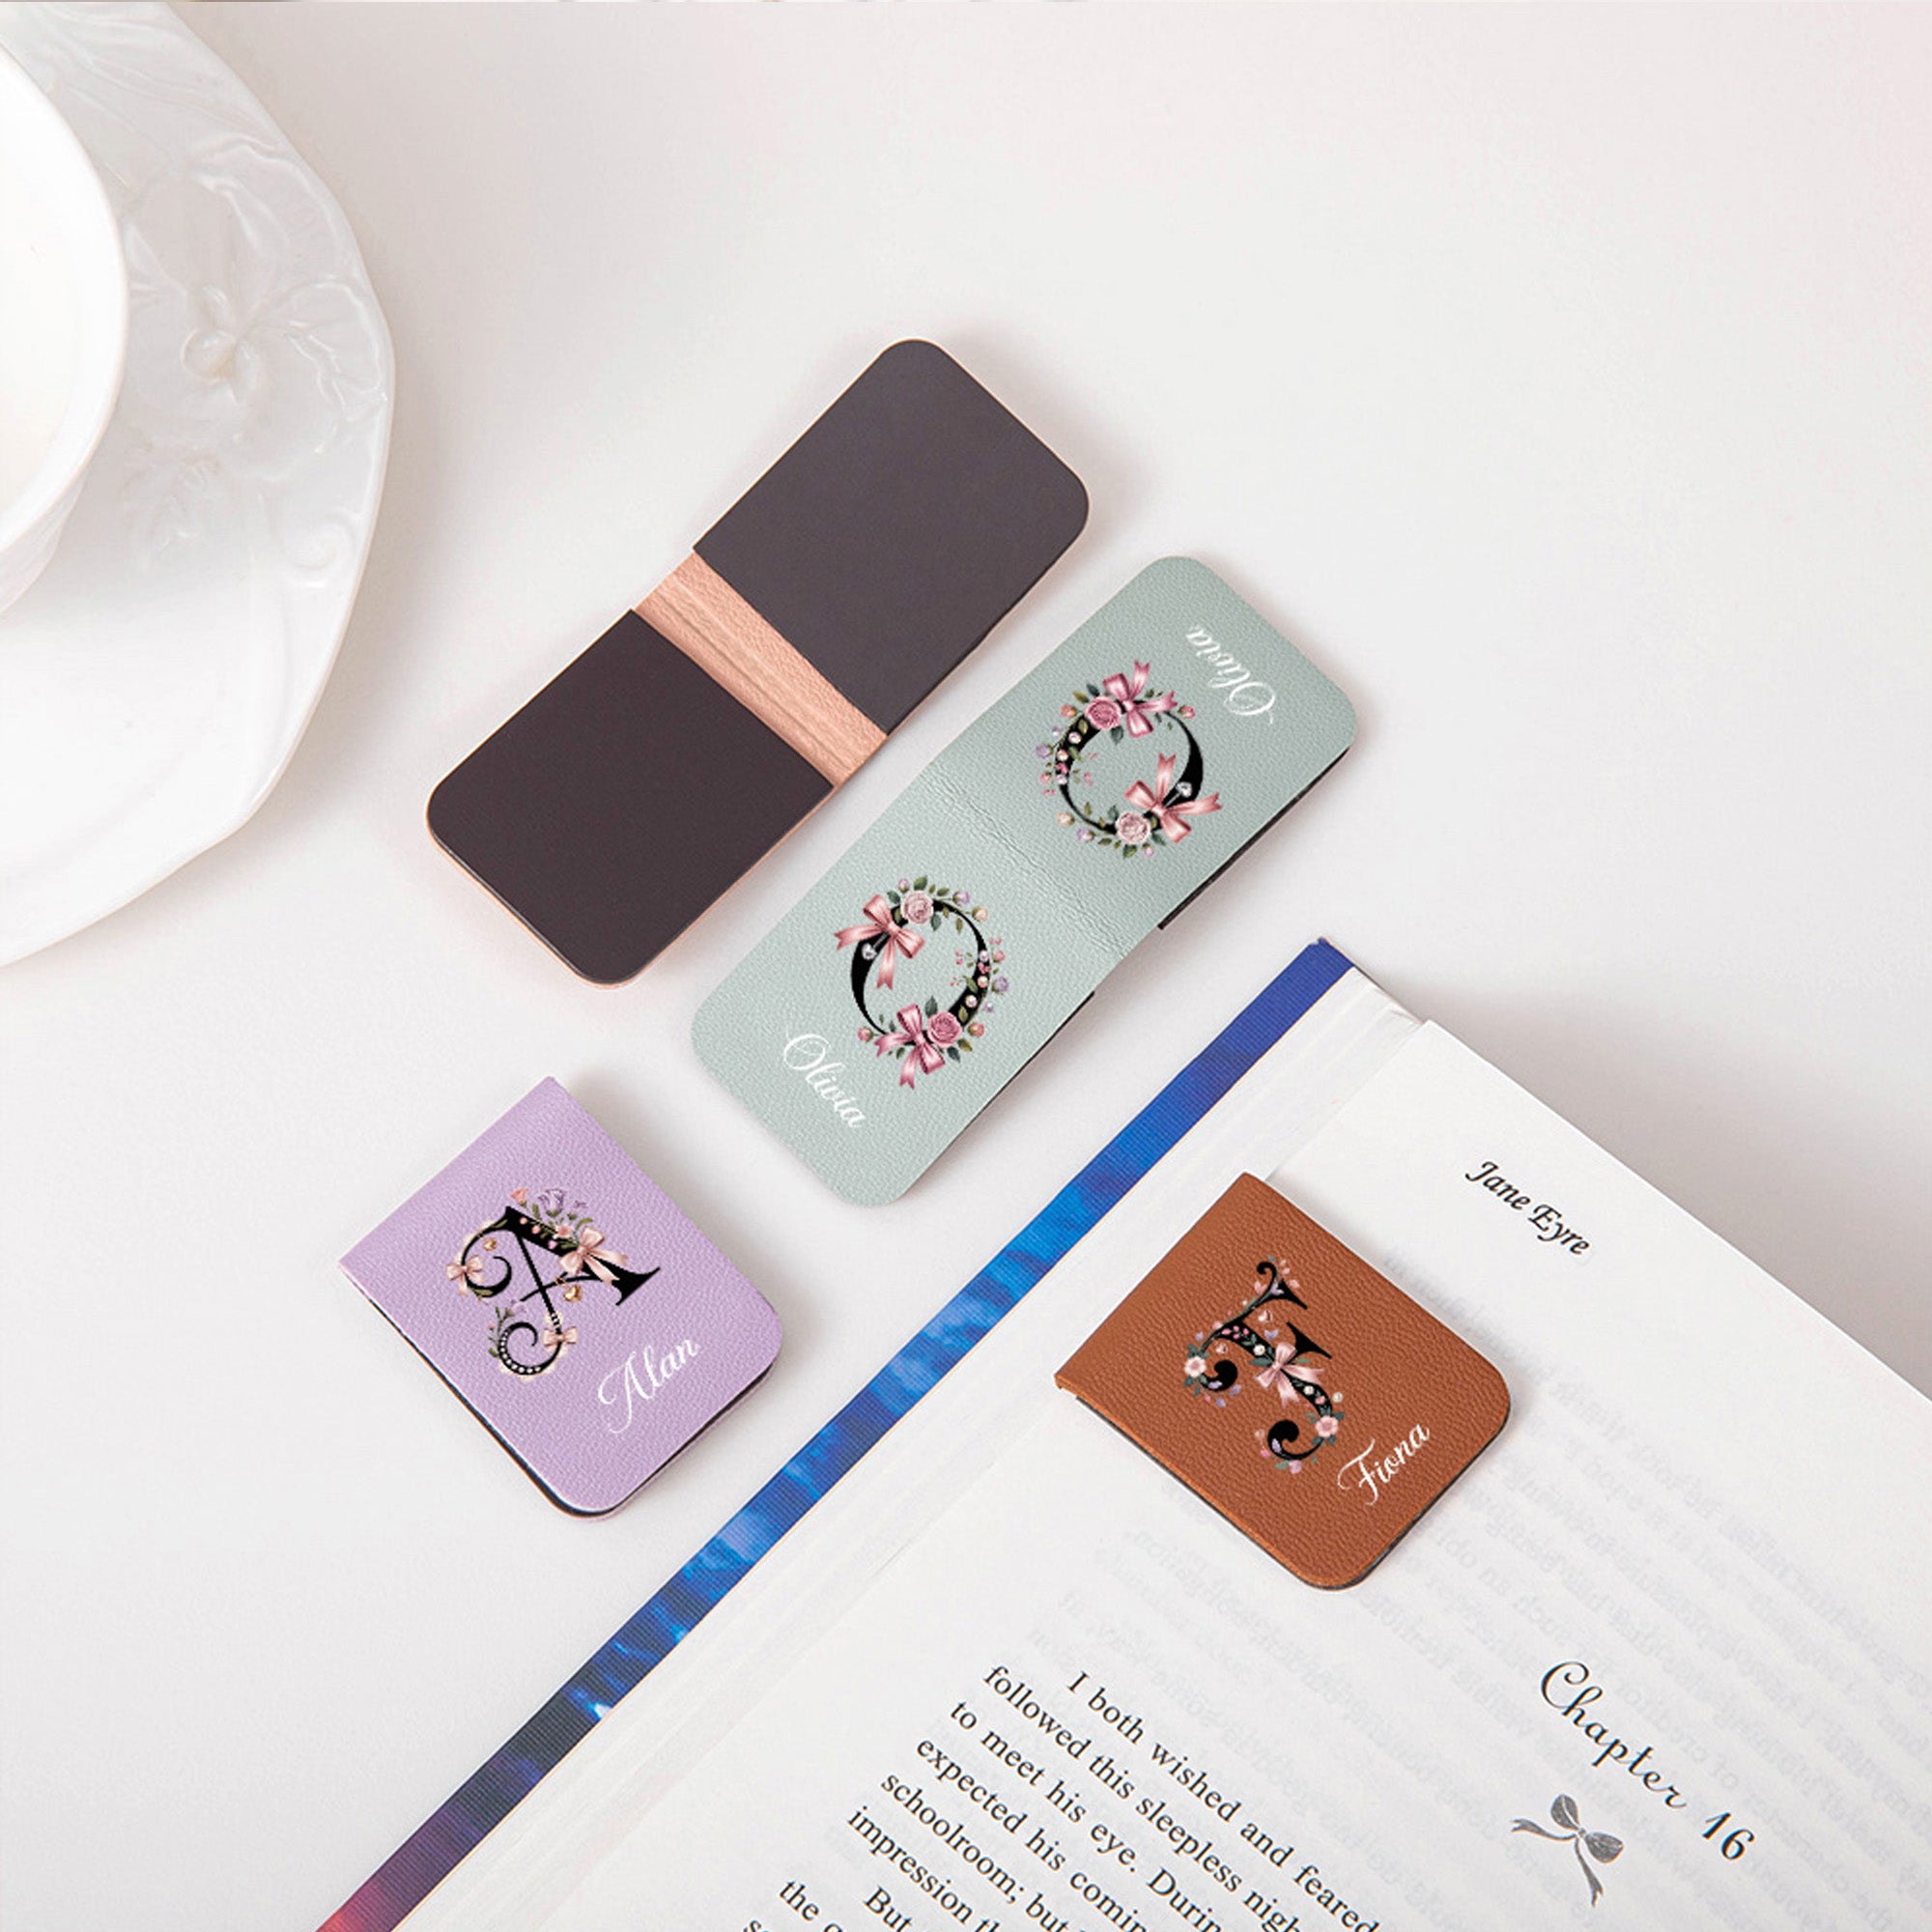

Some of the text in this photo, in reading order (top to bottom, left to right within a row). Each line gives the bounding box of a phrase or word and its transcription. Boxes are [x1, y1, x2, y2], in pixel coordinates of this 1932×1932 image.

[1184, 624, 1275, 724] Olivia
[781, 1028, 867, 1128] Olivia
[1464, 1160, 1592, 1257] Jane Eyre
[597, 1338, 700, 1434] Alan
[1337, 1422, 1431, 1506] Fiona
[916, 1739, 1029, 1834] expected
[1024, 1826, 1067, 1872] his
[950, 1700, 979, 1730] to
[980, 1730, 1046, 1787] meet
[1044, 1778, 1088, 1824] his
[1090, 1823, 1138, 1874] eye.
[981, 1664, 1093, 1760] followed
[1088, 1754, 1135, 1800] this
[1135, 1797, 1243, 1893] sleepless
[1067, 1670, 1090, 1693] I
[1087, 1686, 1145, 1746] both
[1150, 1742, 1243, 1823] wished
[1238, 1822, 1295, 1868] and
[1540, 1661, 1755, 1862] Chapter 16
[778, 1879, 821, 1922] the
[846, 1804, 974, 1925] impression
[863, 1884, 914, 1932] But
[880, 1774, 1070, 1932] schoolroom; but
